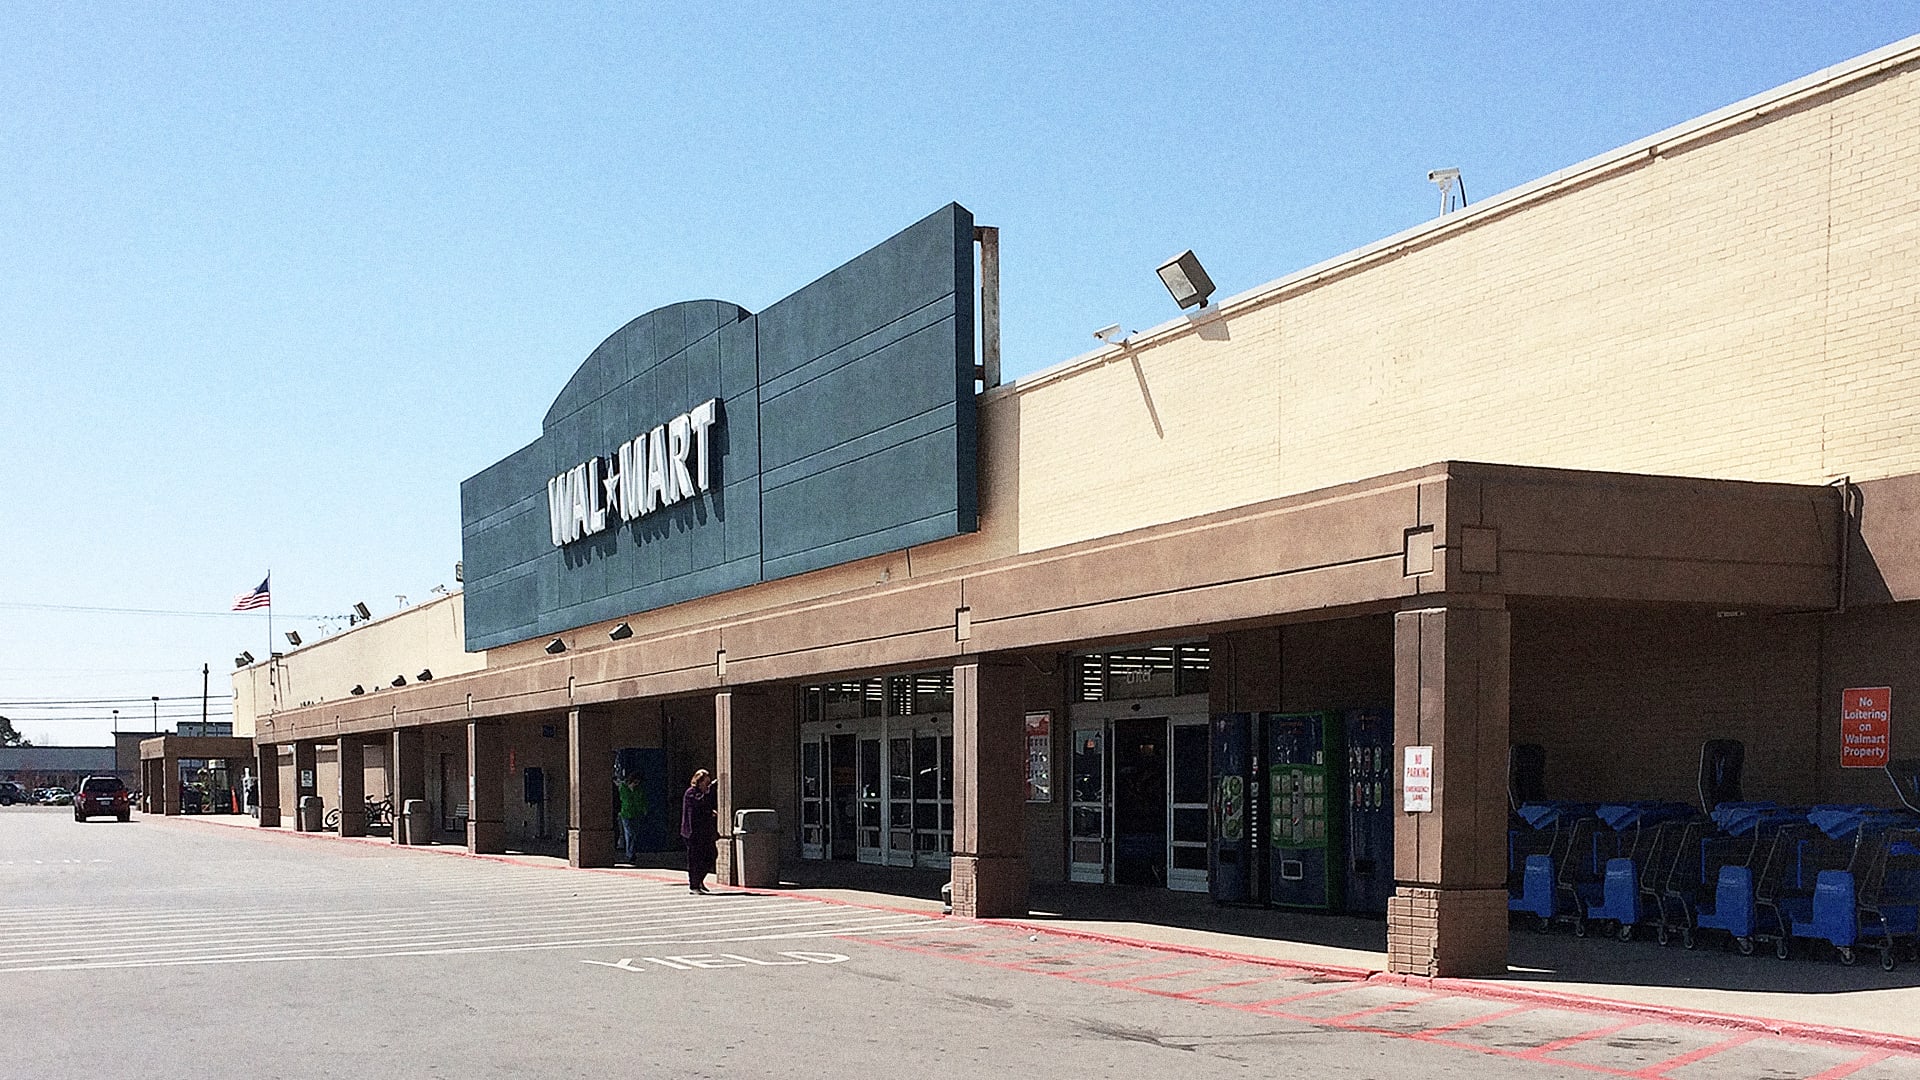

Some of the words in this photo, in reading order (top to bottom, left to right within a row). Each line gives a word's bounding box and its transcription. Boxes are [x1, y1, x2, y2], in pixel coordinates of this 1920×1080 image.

[1859, 697, 1873, 707] No
[1844, 709, 1887, 721] Loitering
[1859, 723, 1872, 731] on
[1845, 733, 1885, 744] Walmart
[1844, 746, 1885, 758] Property
[579, 951, 850, 972] YIELD
